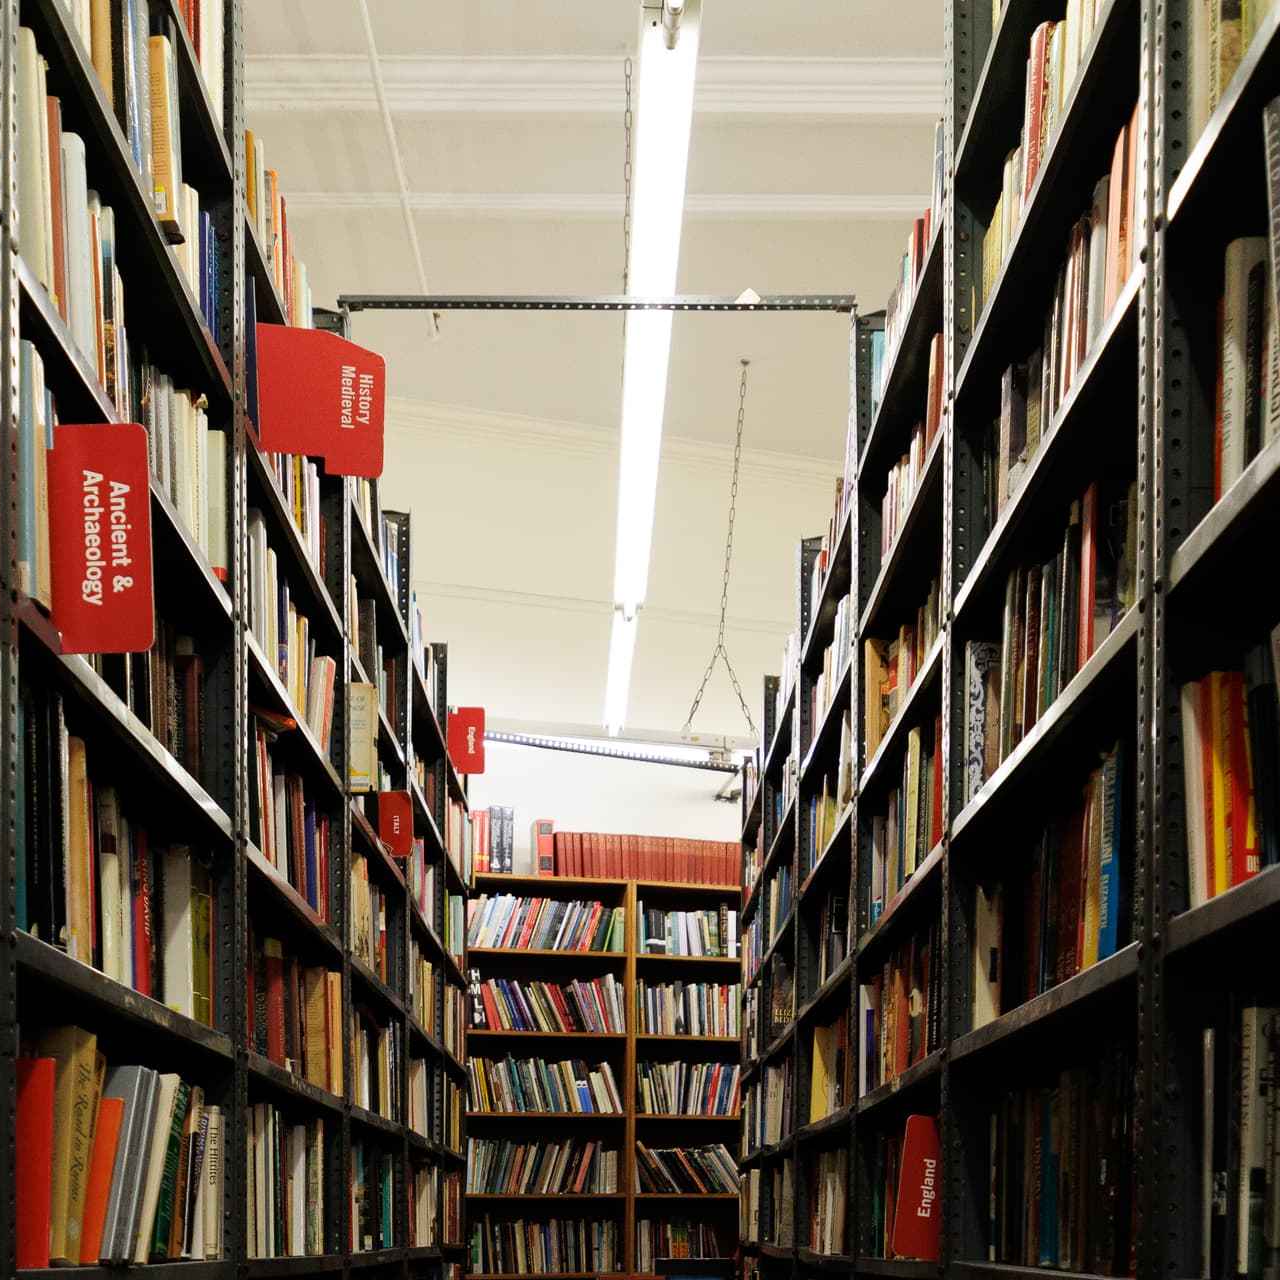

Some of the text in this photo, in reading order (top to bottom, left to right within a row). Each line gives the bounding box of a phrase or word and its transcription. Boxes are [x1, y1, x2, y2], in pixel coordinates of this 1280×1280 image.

[340, 364, 355, 430] Medieval
[358, 373, 373, 425] History
[81, 469, 104, 607] Archaeology
[109, 480, 134, 594] Ancient &
[467, 725, 477, 754] England
[392, 814, 400, 836] ITALY
[78, 1063, 92, 1088] The
[73, 1094, 89, 1137] Road
[209, 1125, 220, 1186] The Hittites
[916, 1157, 937, 1219] England
